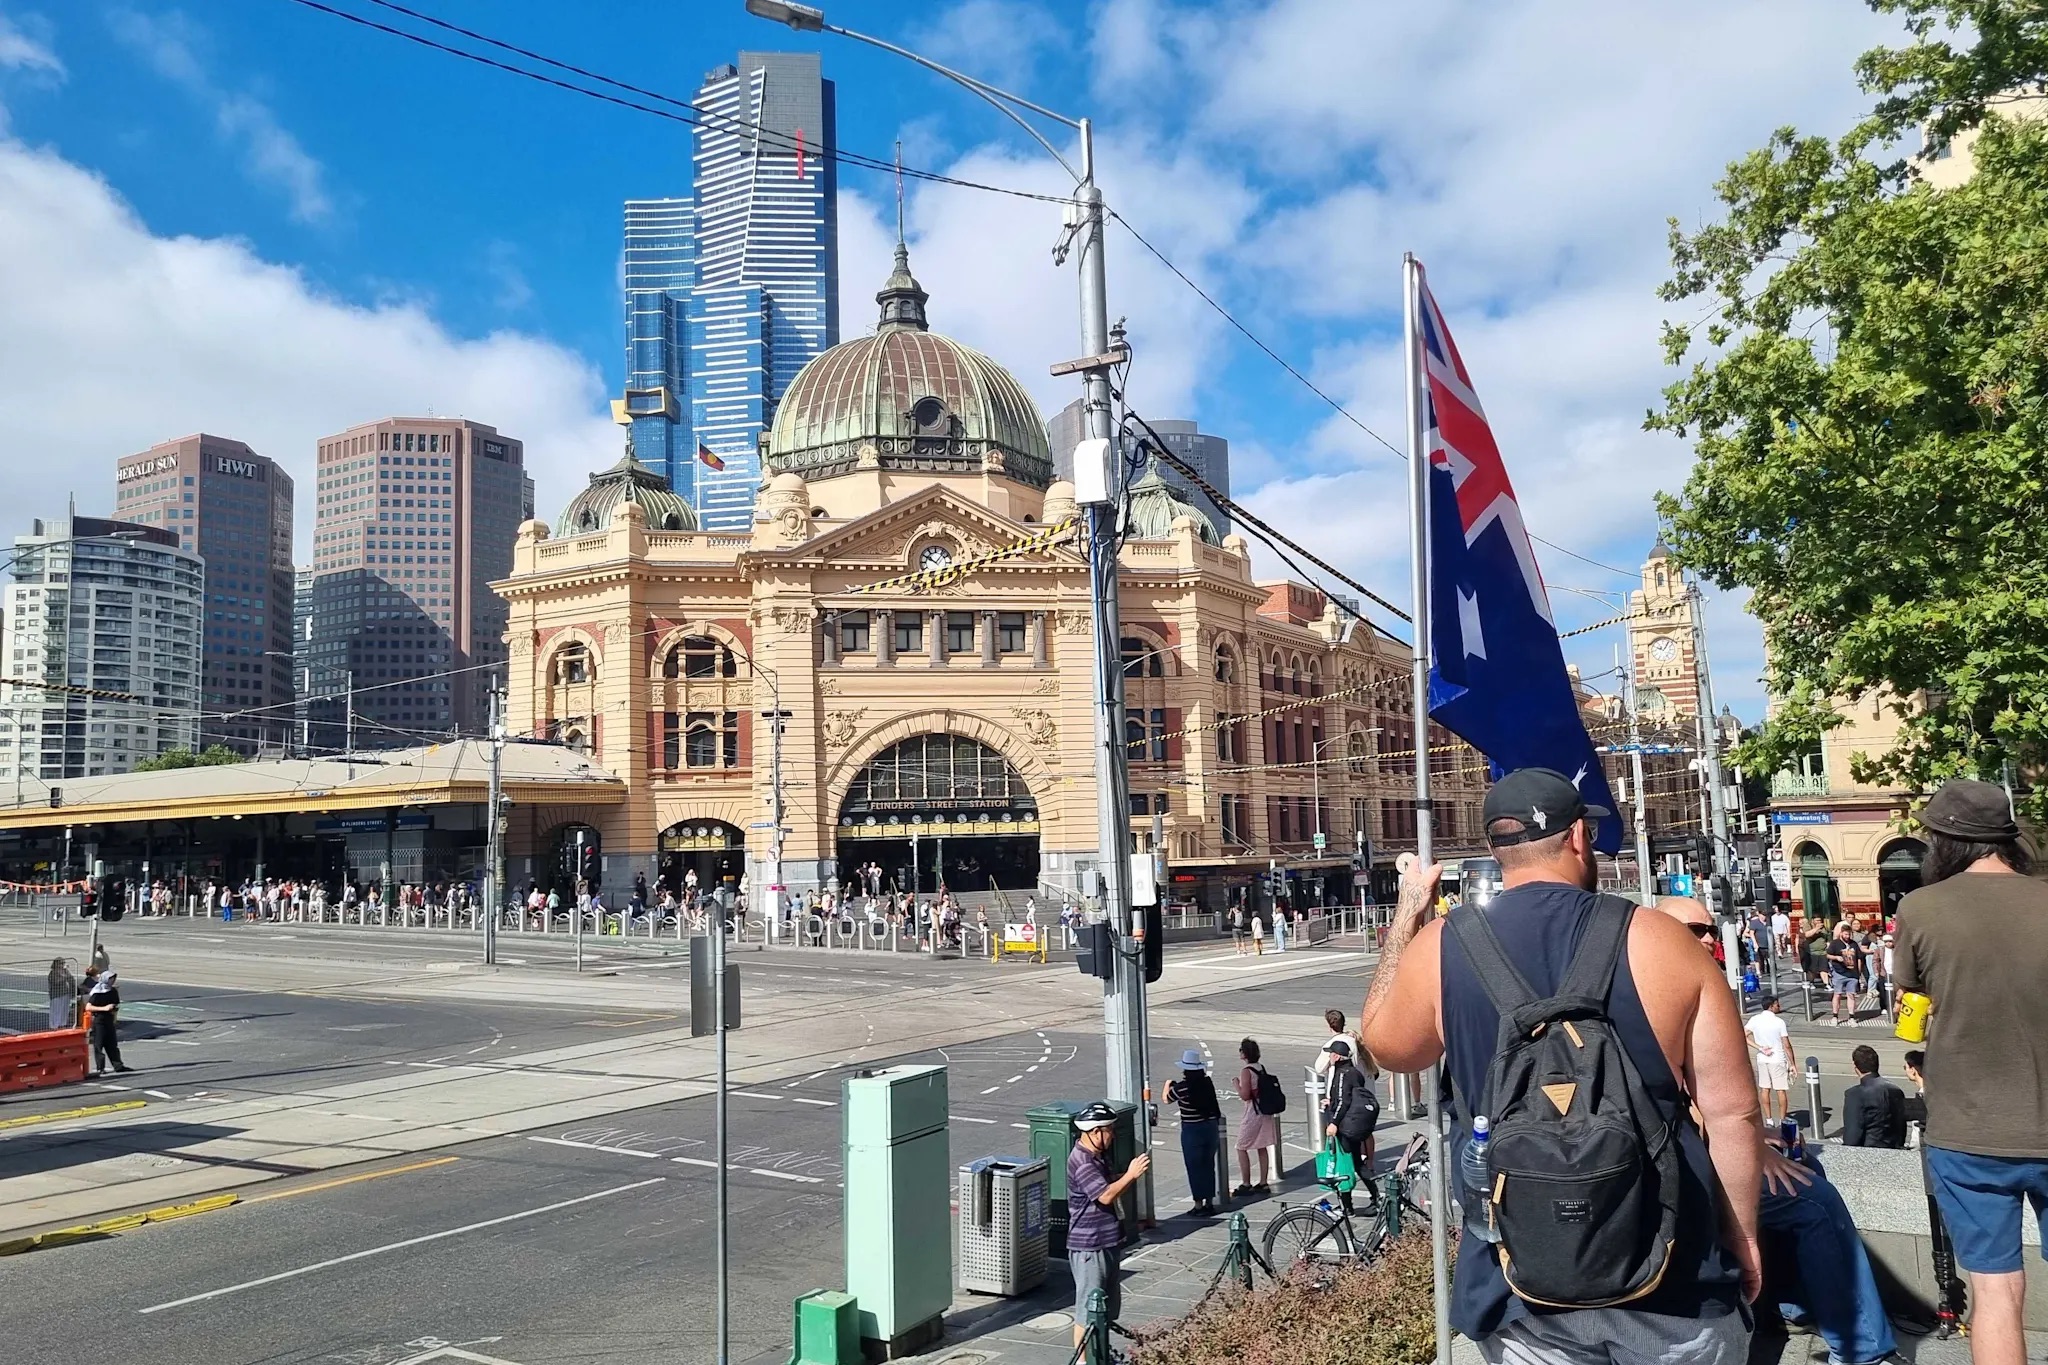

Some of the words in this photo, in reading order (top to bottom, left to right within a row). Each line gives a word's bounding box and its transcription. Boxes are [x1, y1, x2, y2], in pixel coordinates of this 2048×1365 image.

[486, 443, 502, 454] IBM
[116, 462, 154, 481] HERALD
[157, 456, 178, 471] SUN
[217, 457, 256, 477] HWT
[870, 801, 915, 810] FLINDERS
[925, 800, 959, 809] STREET
[969, 800, 1009, 808] STATION
[1789, 814, 1821, 822] Swanston
